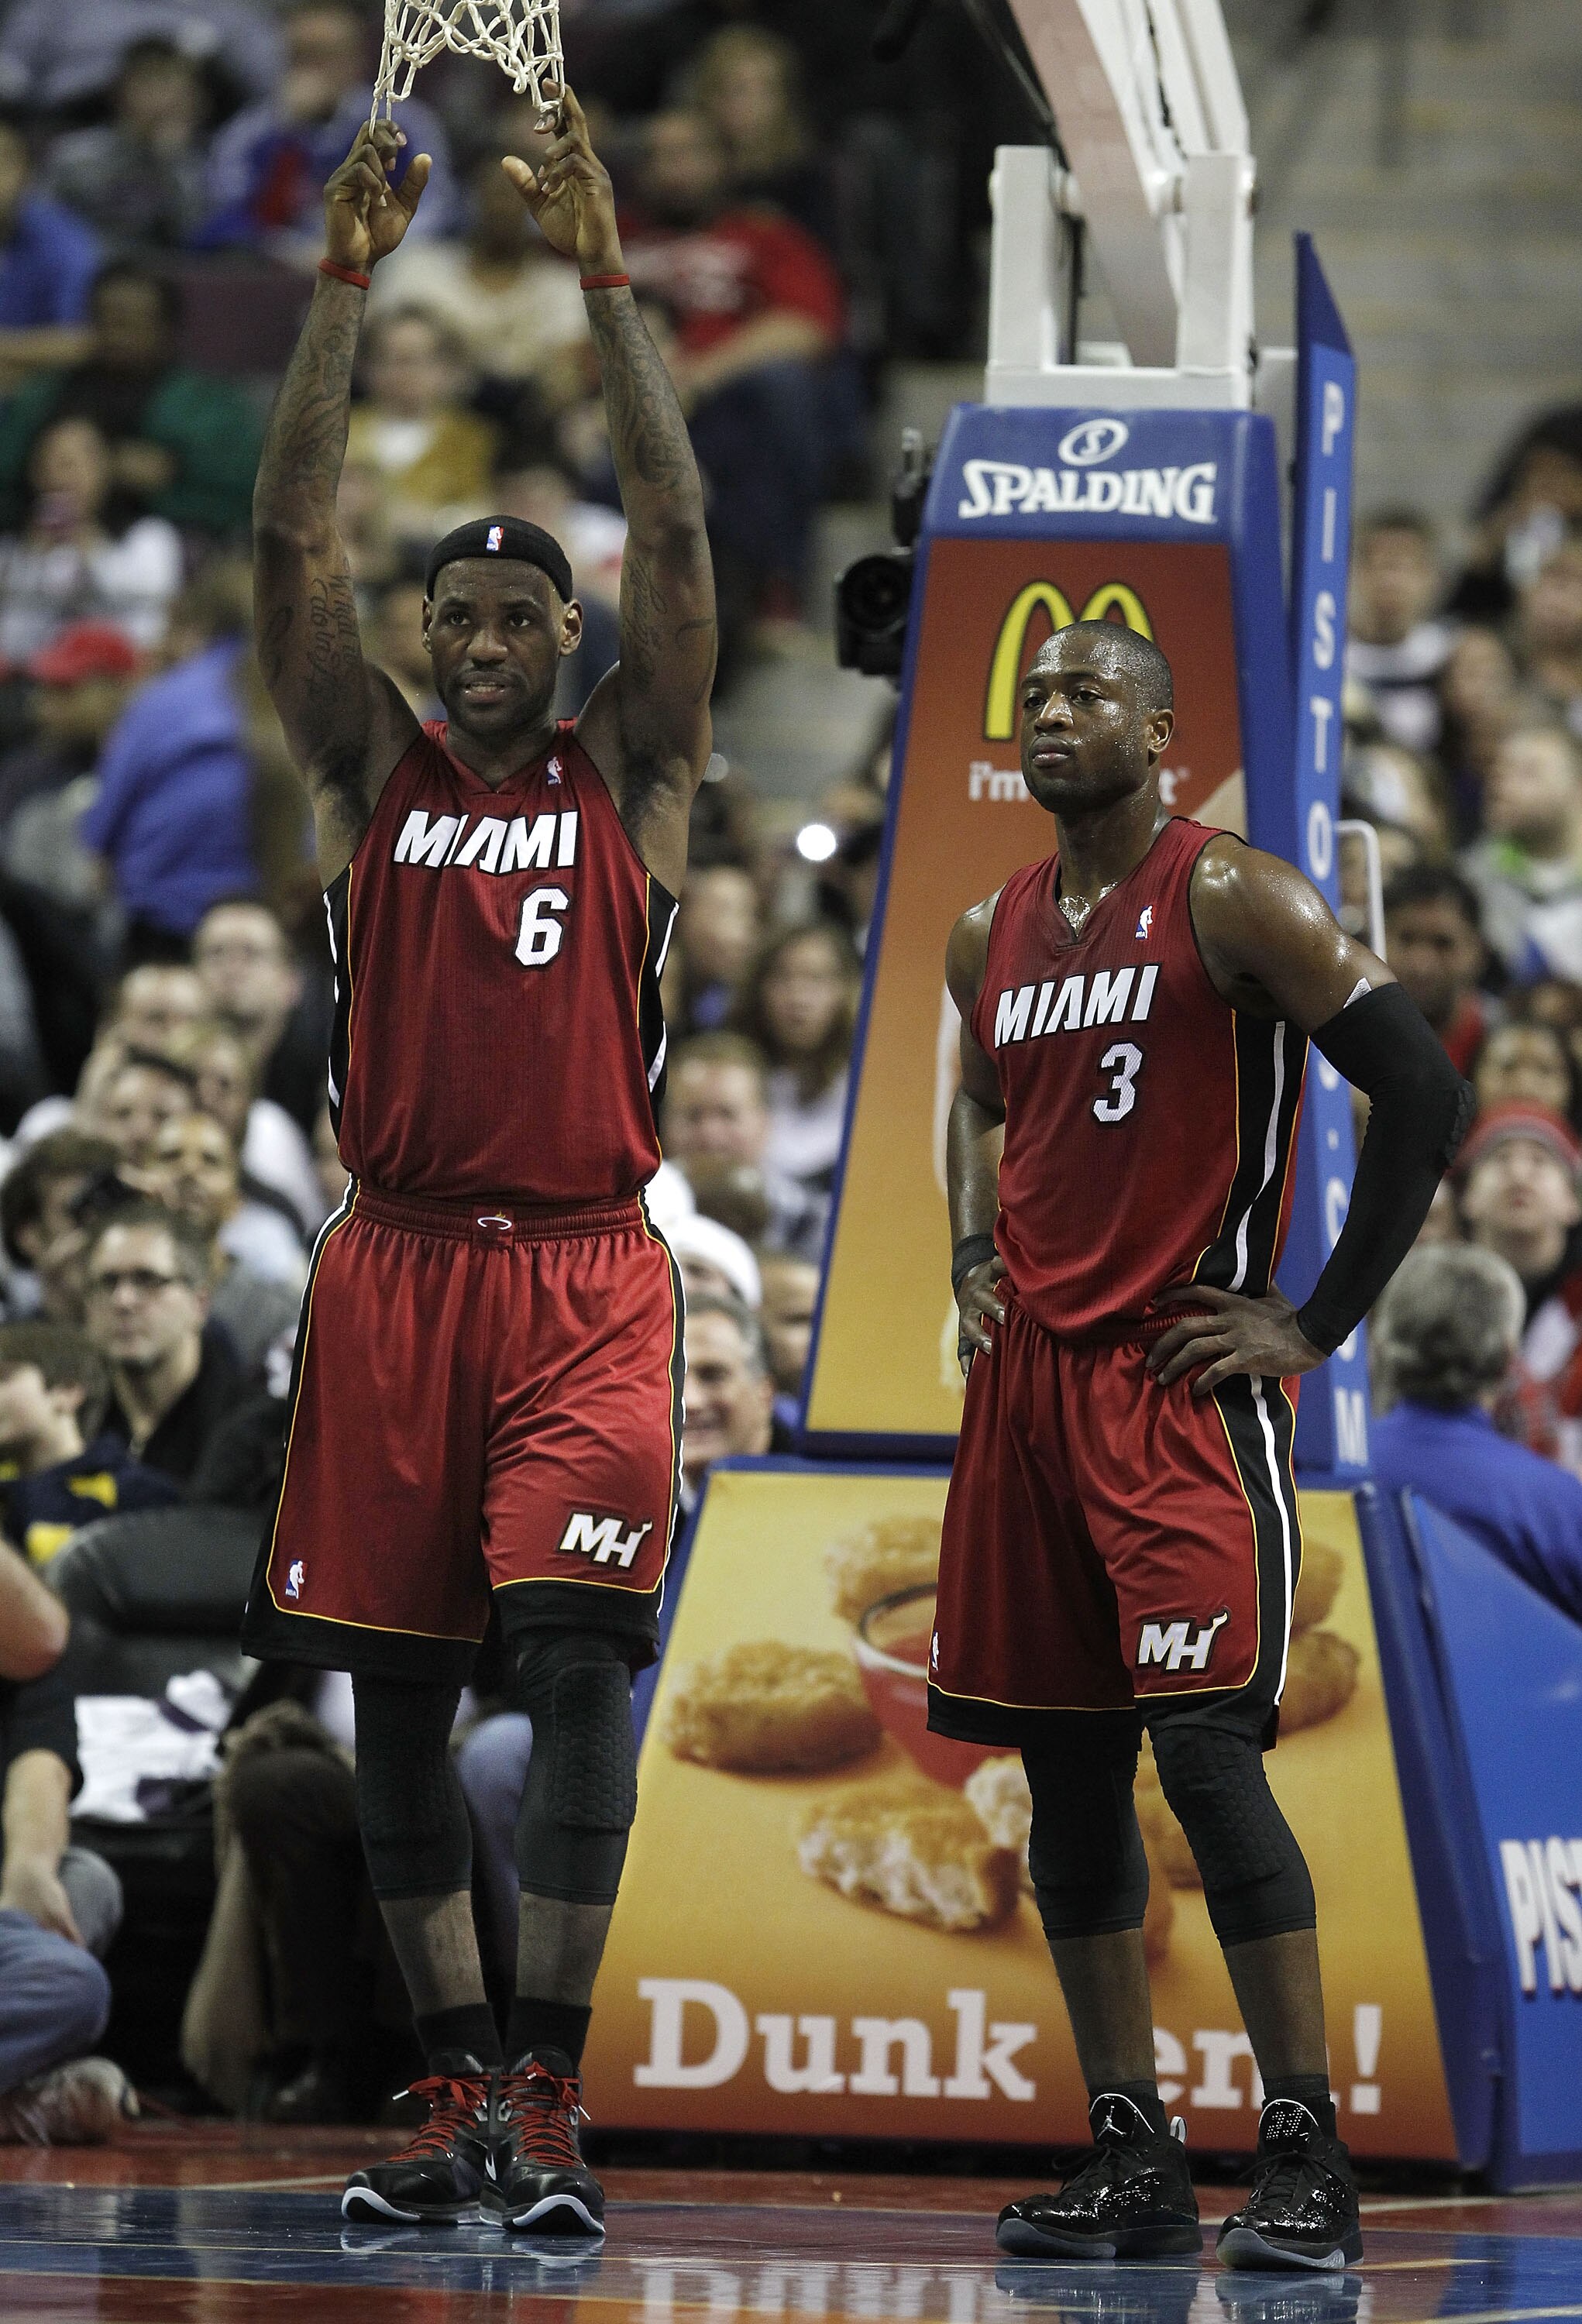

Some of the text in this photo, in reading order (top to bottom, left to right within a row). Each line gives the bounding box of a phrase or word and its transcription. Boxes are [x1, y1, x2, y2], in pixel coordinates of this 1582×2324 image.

[958, 458, 1219, 524] SPALDING
[393, 810, 579, 874] MIAMI
[514, 888, 570, 967] 6
[995, 964, 1160, 1049] MIAMI
[1092, 1043, 1144, 1122] 3
[633, 1976, 1037, 2102] Dunk
